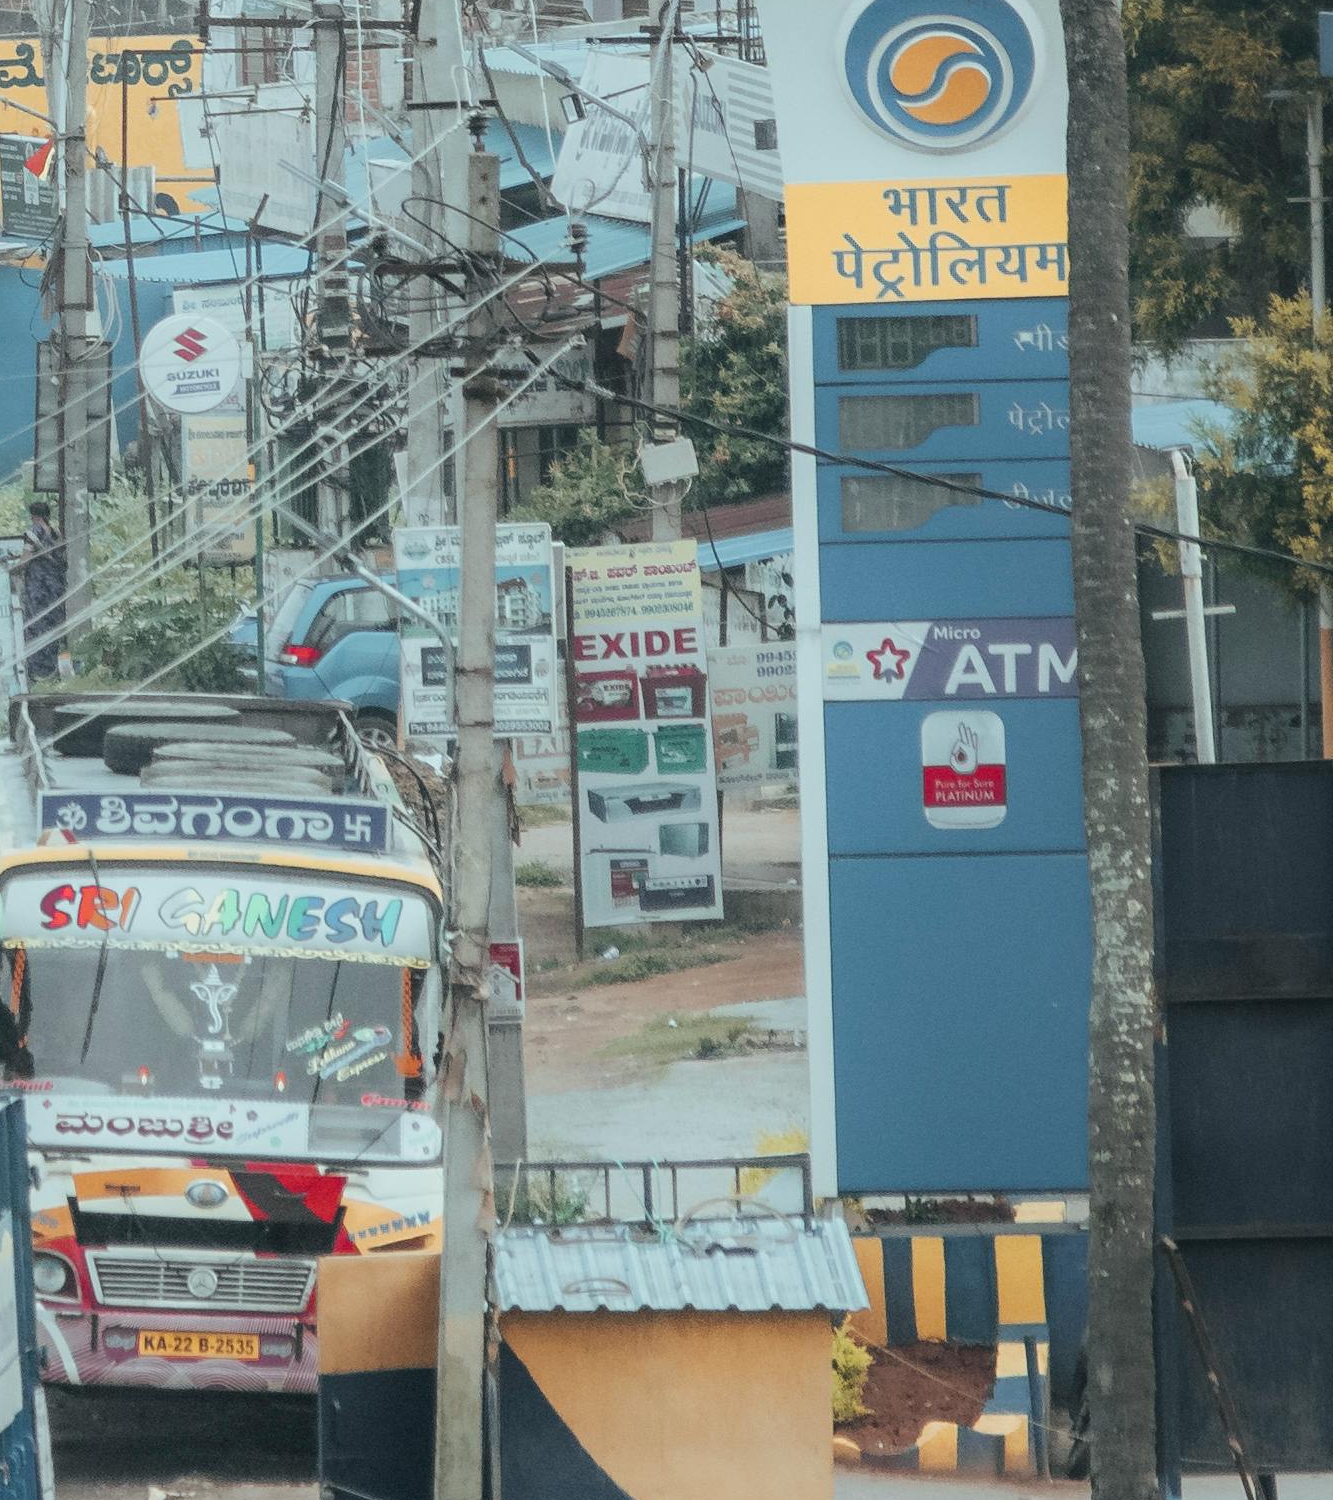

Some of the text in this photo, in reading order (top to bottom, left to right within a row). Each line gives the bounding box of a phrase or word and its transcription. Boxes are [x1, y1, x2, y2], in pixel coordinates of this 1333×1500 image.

[883, 184, 1012, 226] भारत
[832, 231, 1068, 298] पेट्रोलियम
[166, 368, 220, 382] SUZUKI
[573, 627, 698, 661] EXIDE
[934, 627, 981, 640] Micro
[945, 643, 1077, 695] ATM
[935, 790, 995, 802] PLATINUM
[95, 797, 333, 842] ಶಿವಗಂಗಾ
[39, 884, 403, 948] SRI GANESH
[144, 1337, 254, 1355] KA-22 B-2535
